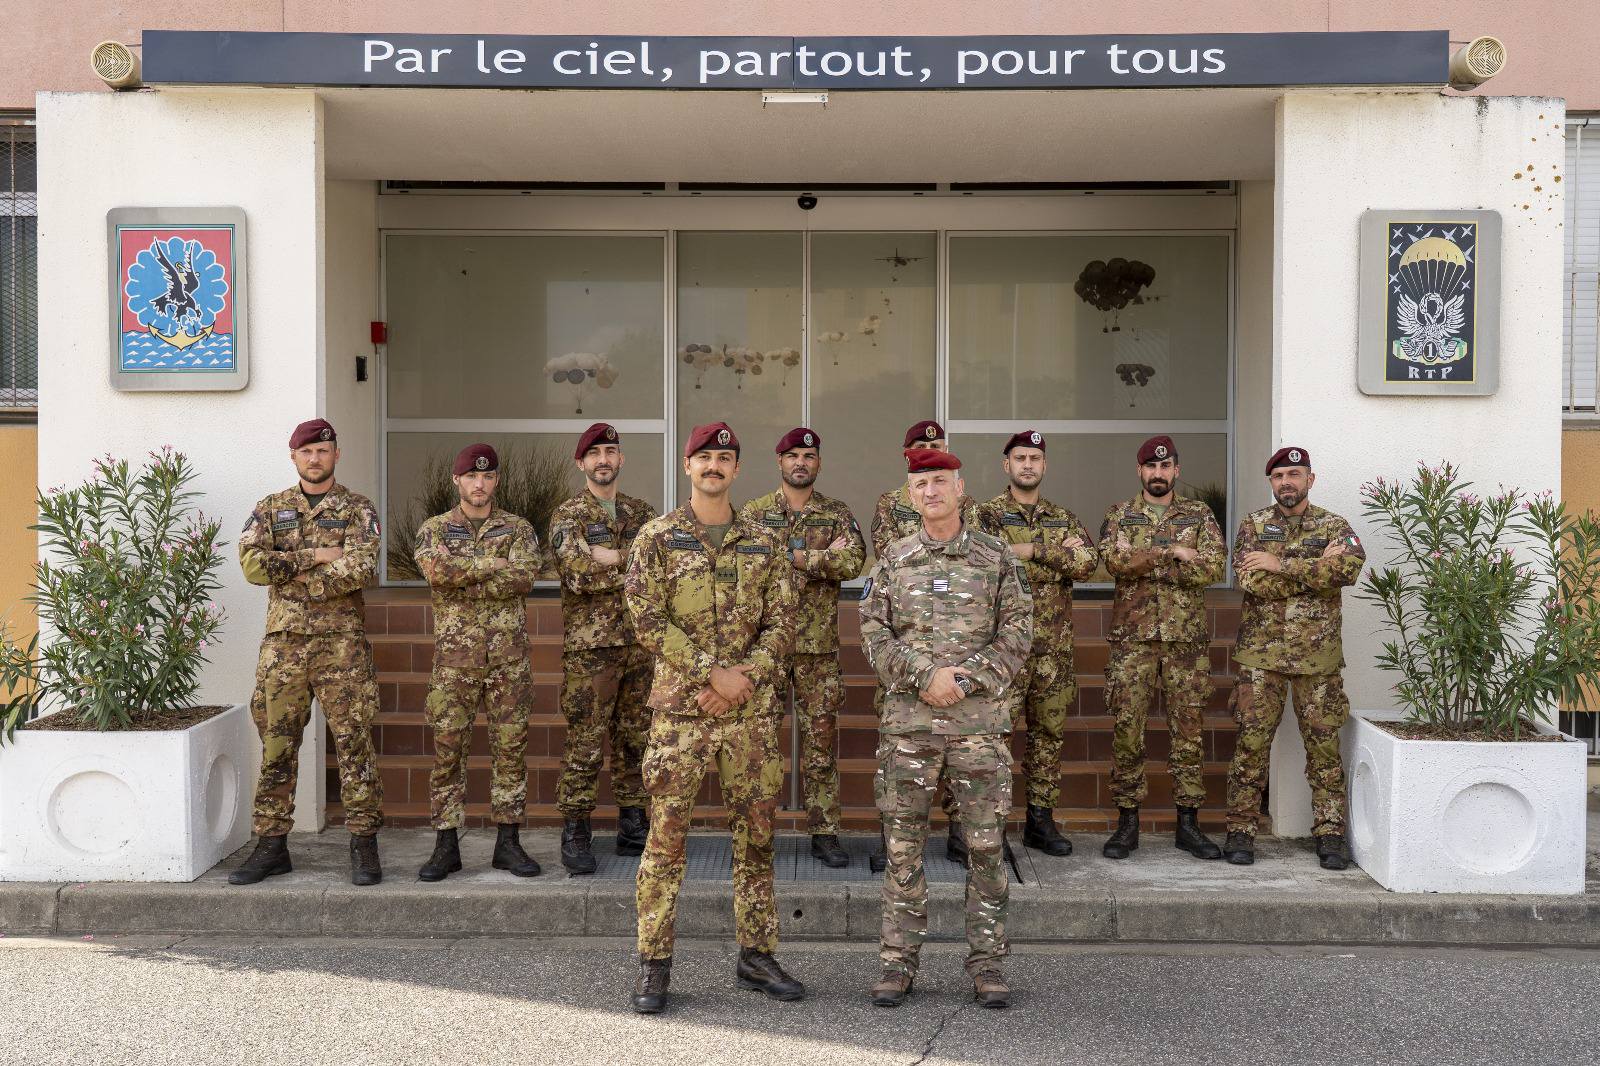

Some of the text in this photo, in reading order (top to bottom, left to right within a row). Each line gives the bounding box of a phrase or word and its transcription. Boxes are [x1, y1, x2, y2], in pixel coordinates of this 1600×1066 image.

[363, 40, 1226, 83] Par le ciel, partout, pour tous
[1426, 343, 1434, 357] 1
